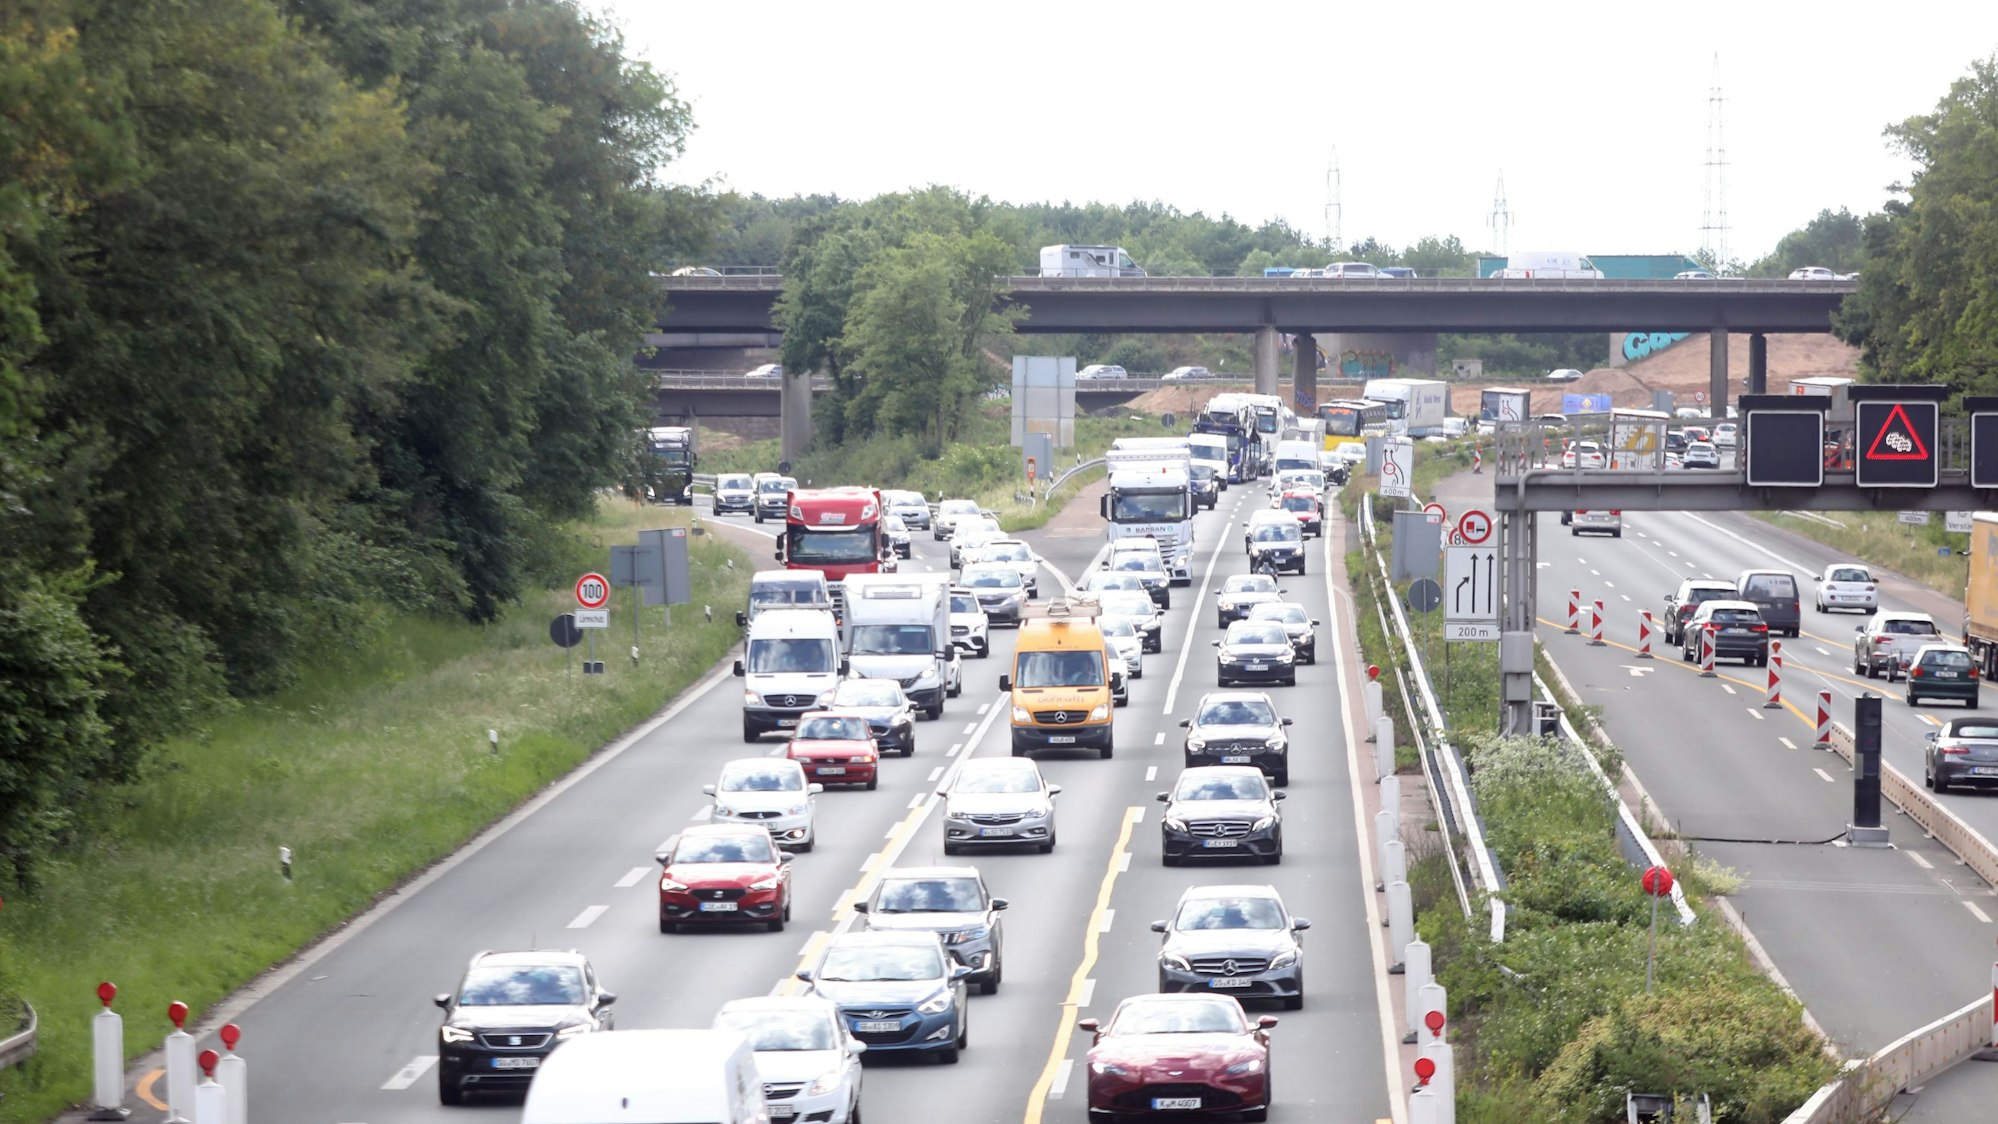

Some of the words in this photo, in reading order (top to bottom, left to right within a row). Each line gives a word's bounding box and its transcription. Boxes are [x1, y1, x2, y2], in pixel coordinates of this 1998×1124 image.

[1135, 526, 1166, 534] BARSAN
[582, 584, 603, 599] 100
[1458, 627, 1477, 637] 200
